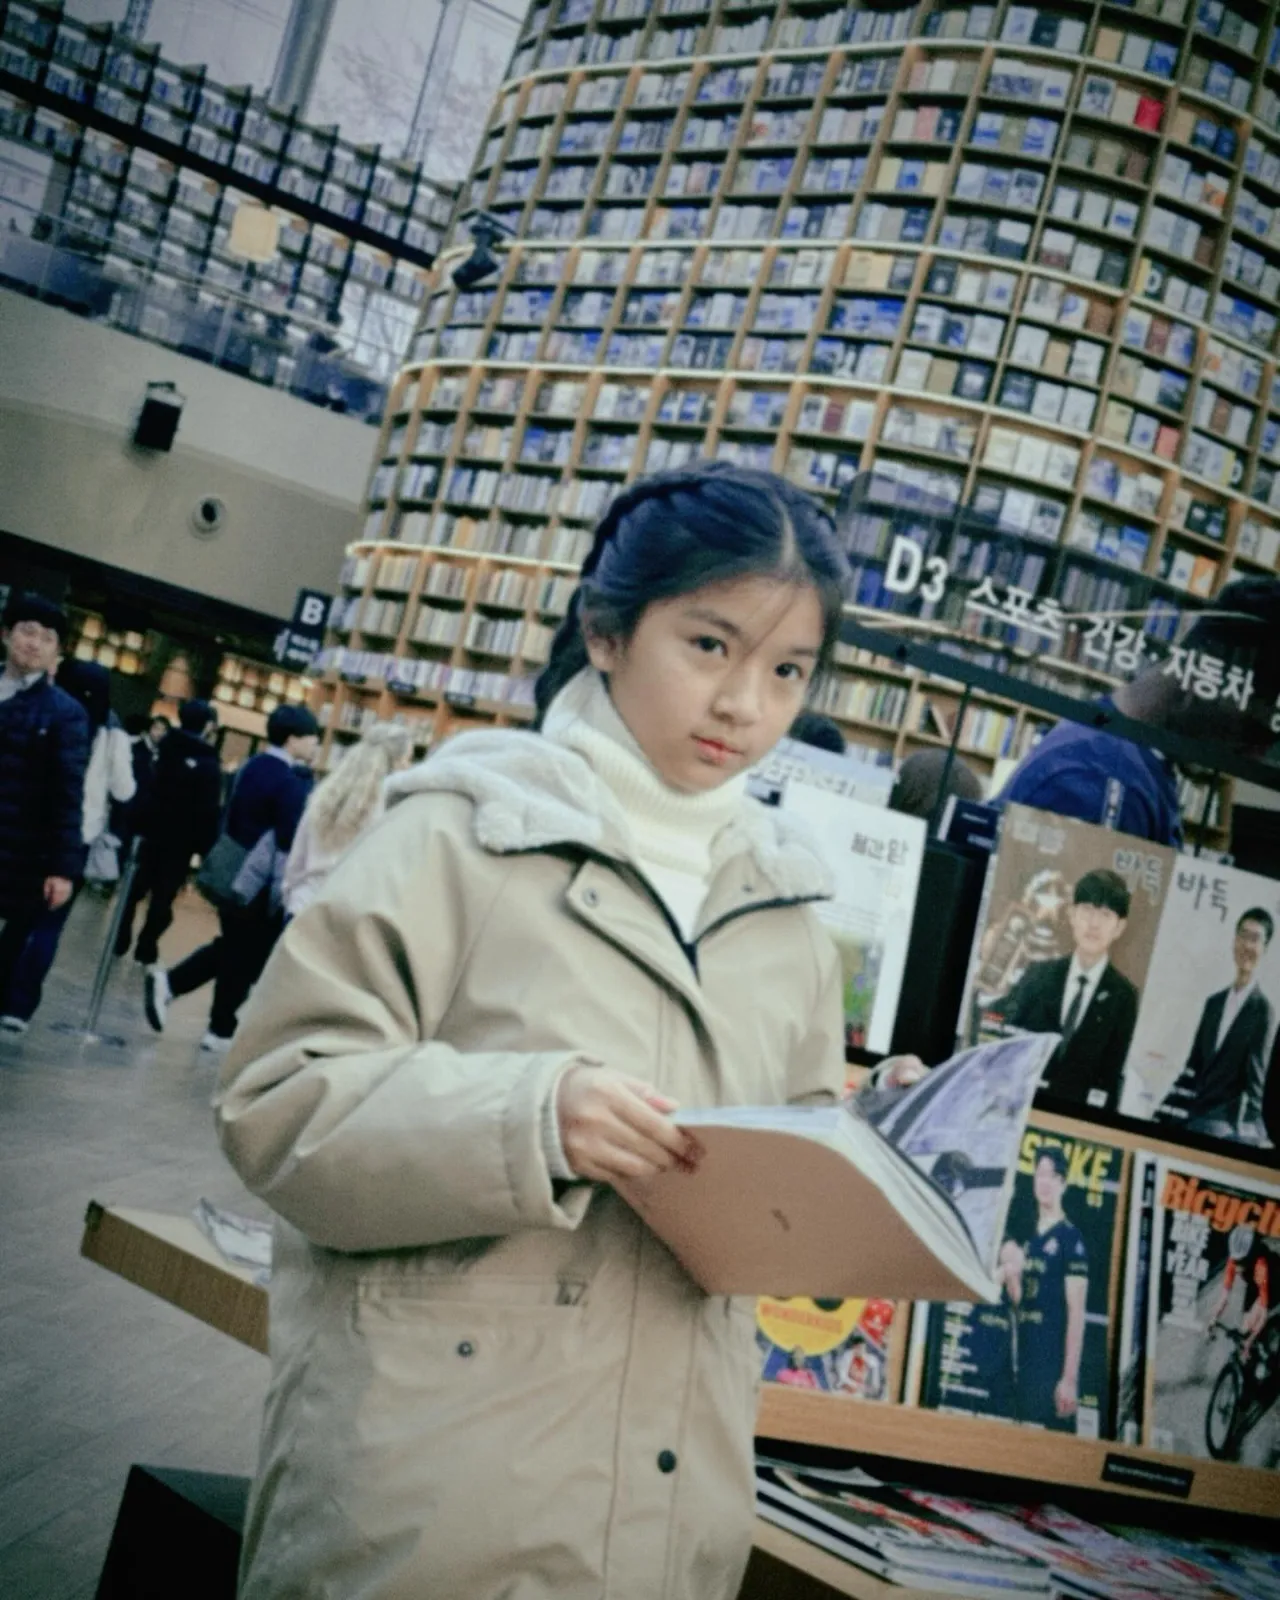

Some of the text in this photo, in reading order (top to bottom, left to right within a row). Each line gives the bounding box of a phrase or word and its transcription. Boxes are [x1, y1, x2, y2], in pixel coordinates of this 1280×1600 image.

[884, 535, 949, 603] D3
[301, 596, 325, 626] B
[1178, 871, 1229, 923] 바둑
[1018, 1131, 1113, 1193] SKE
